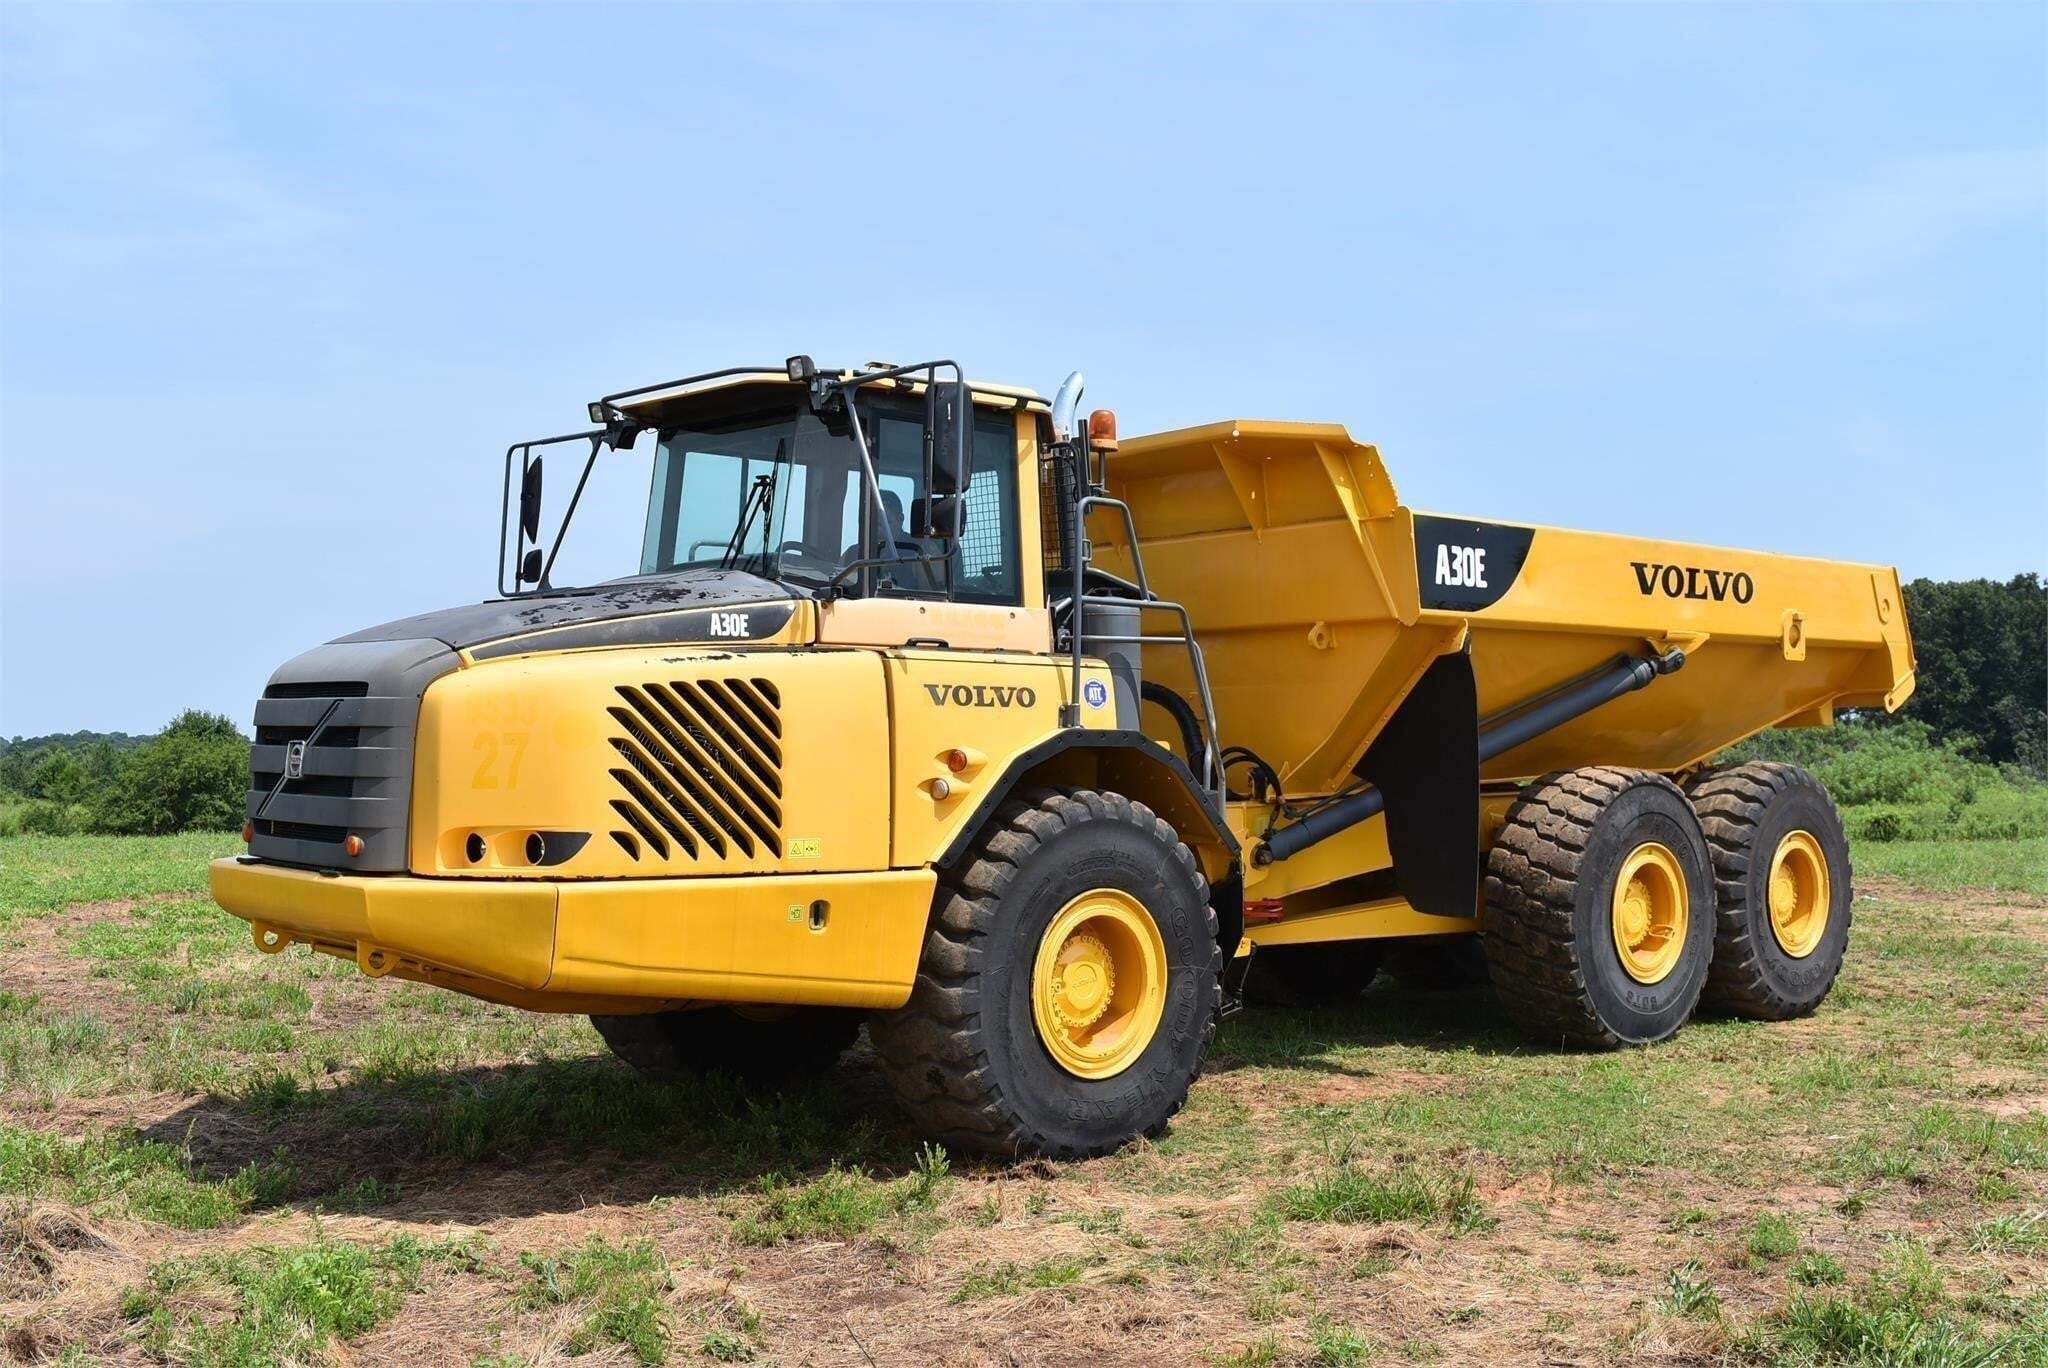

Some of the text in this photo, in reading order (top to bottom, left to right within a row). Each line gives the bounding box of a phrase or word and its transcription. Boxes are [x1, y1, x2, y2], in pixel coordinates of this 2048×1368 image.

[1435, 544, 1488, 588] A30E
[1630, 562, 1754, 604] VOLVO
[710, 612, 750, 637] A30E
[923, 684, 1036, 708] VOLVO
[472, 731, 529, 789] 27
